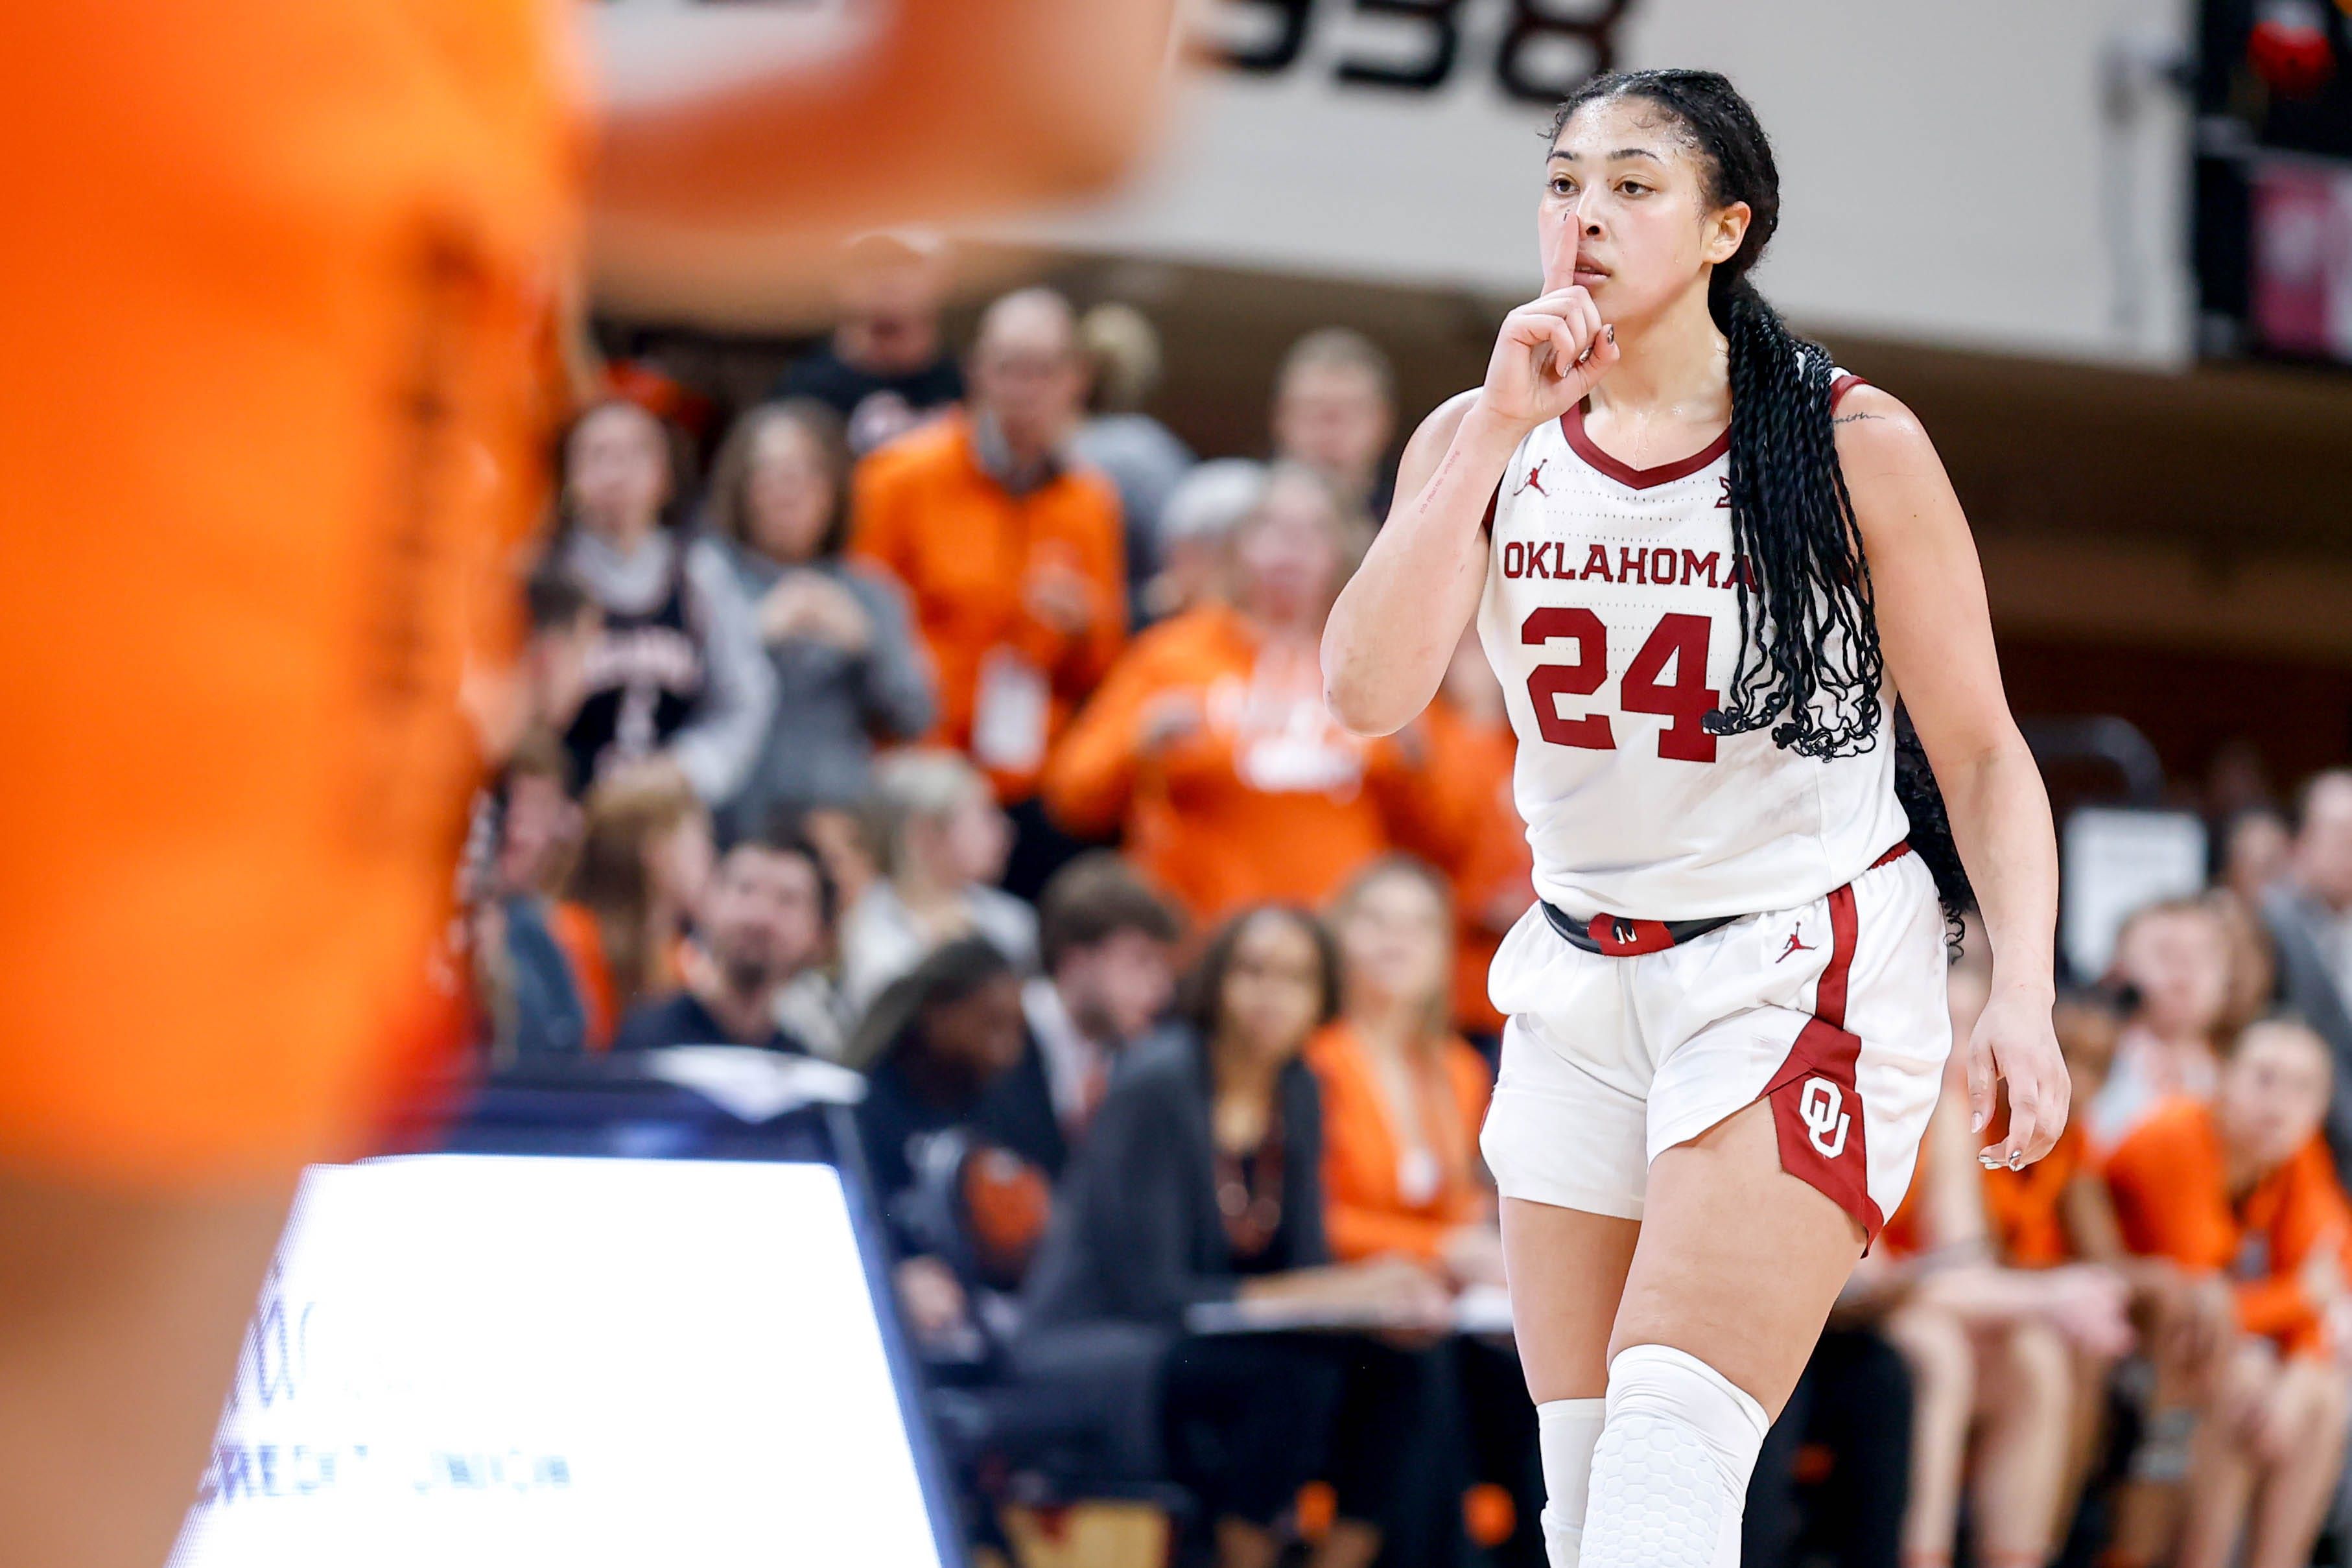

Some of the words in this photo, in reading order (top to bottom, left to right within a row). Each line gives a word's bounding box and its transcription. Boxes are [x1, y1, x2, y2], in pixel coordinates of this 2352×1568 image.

[1505, 541, 1759, 594] OKLAHOMA
[1522, 607, 1720, 764] 24
[1799, 1077, 1852, 1158] OU
